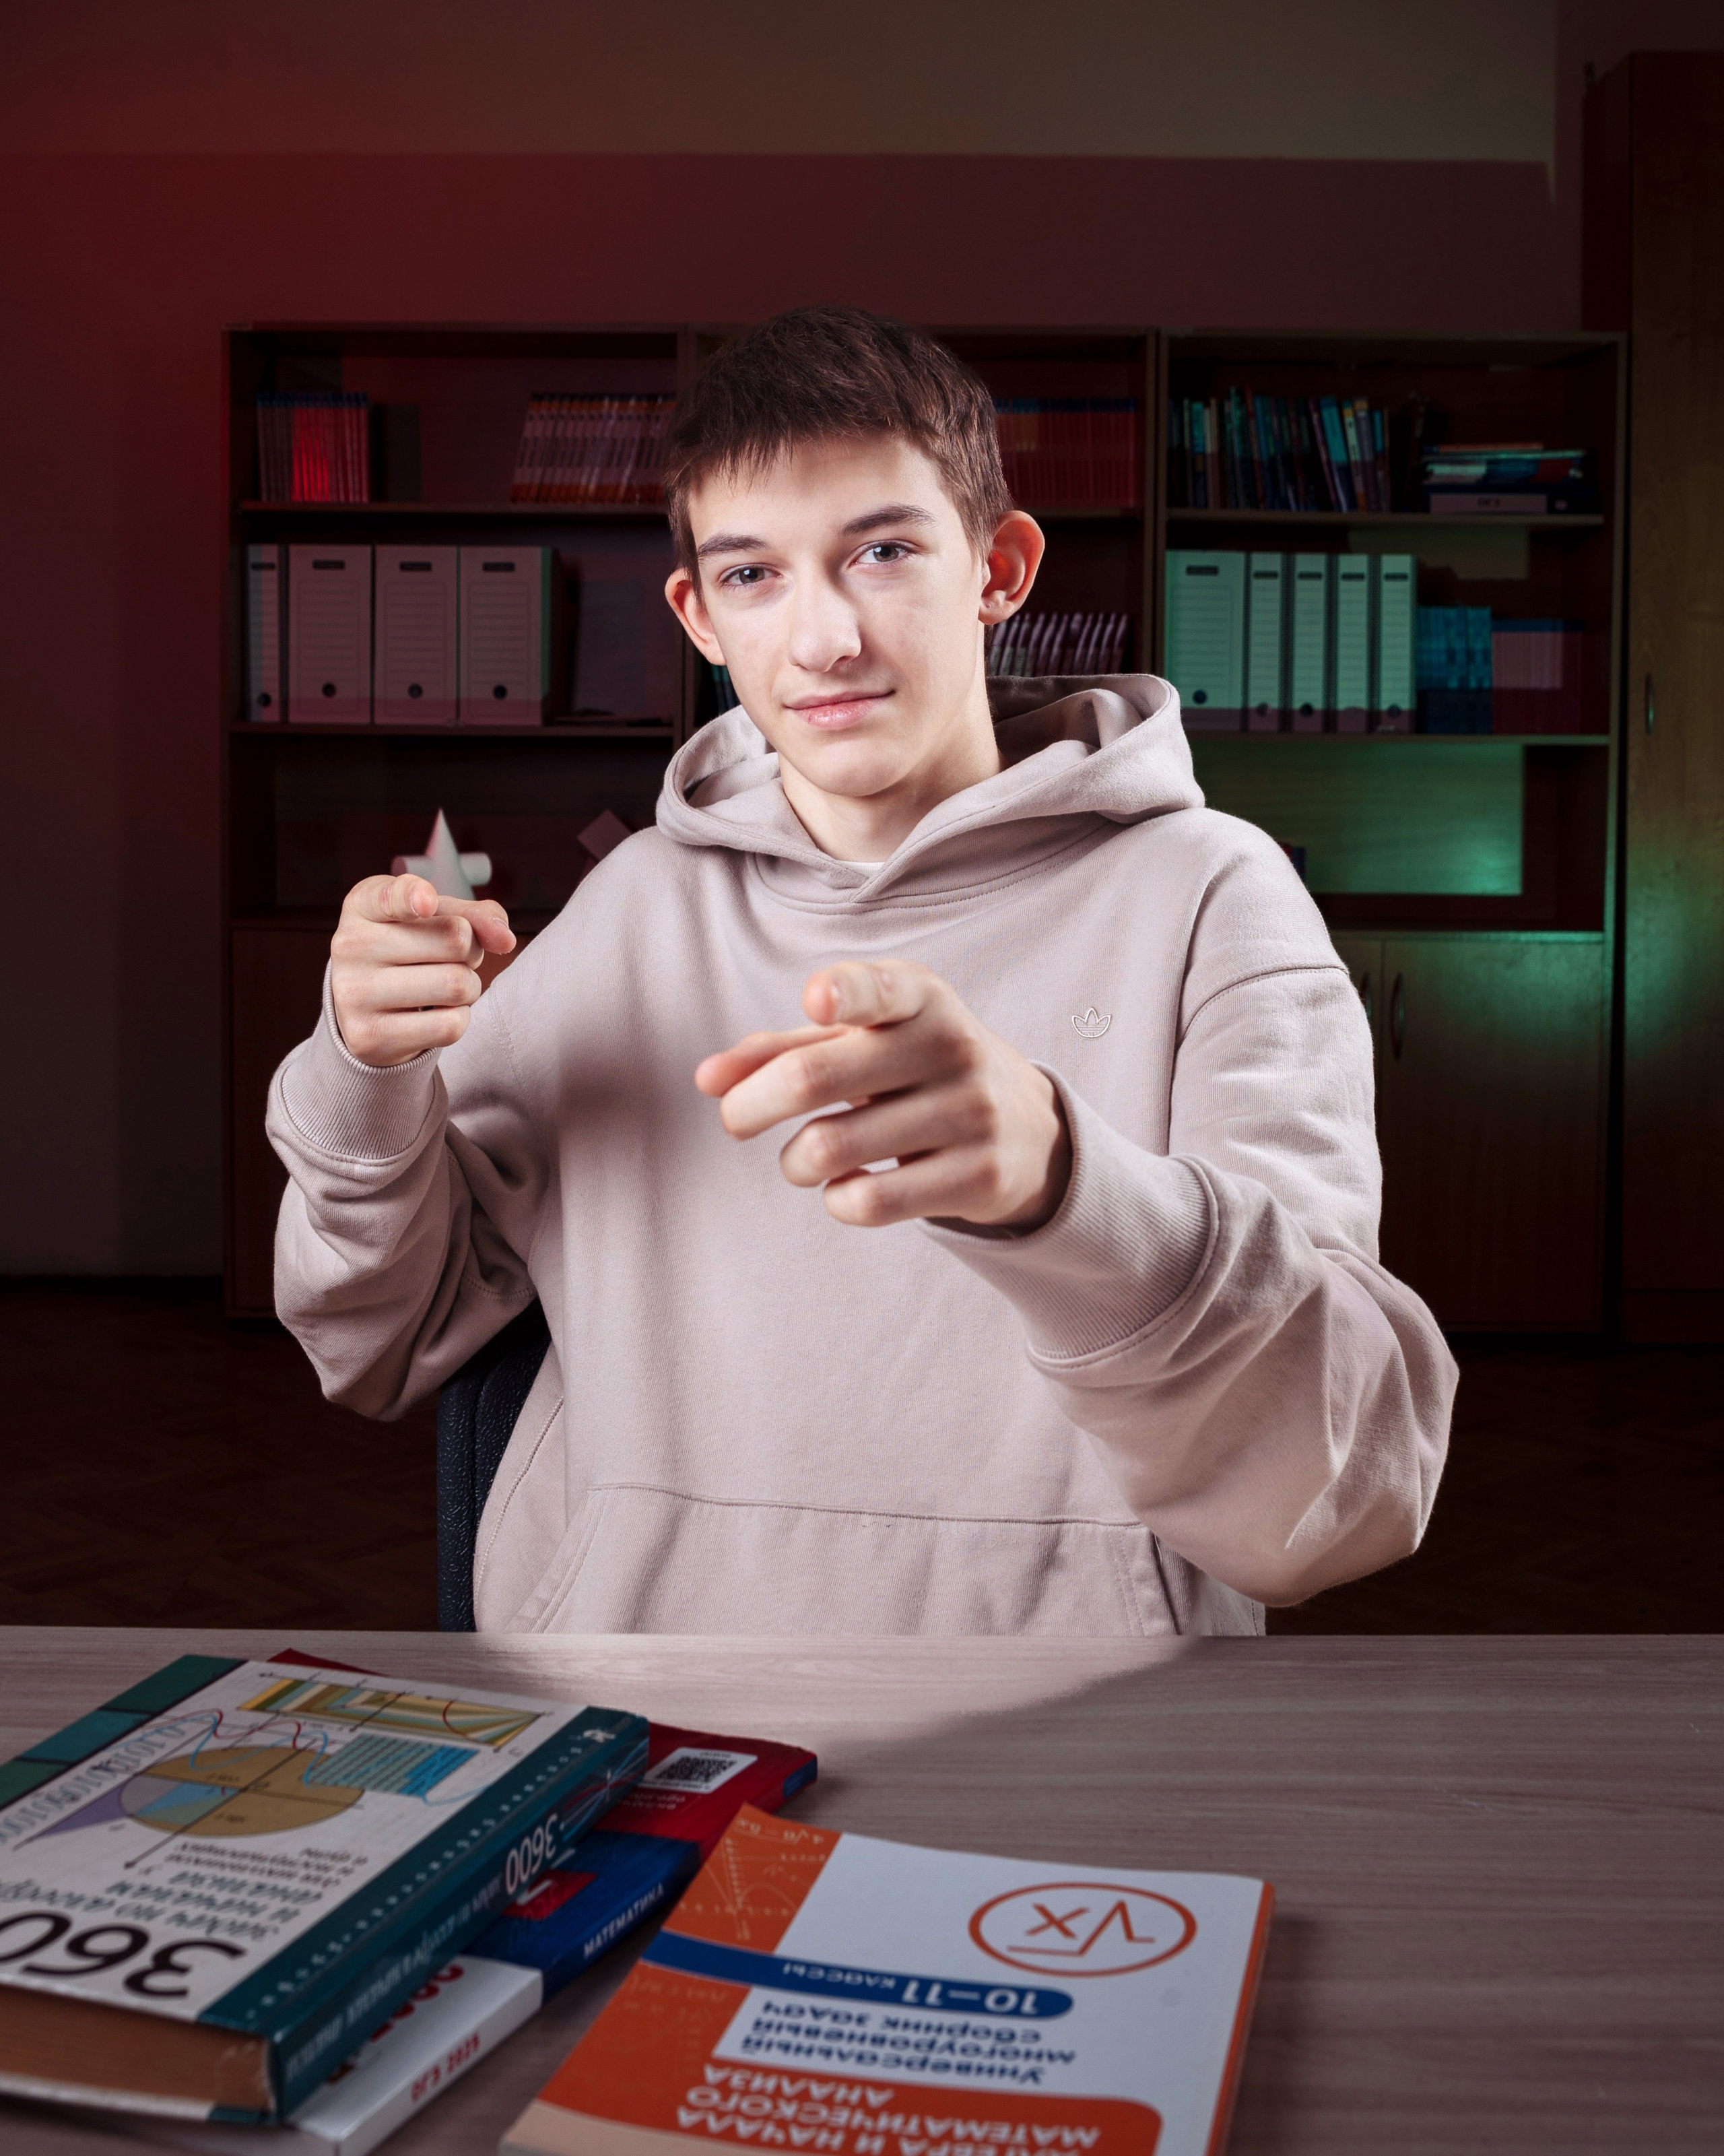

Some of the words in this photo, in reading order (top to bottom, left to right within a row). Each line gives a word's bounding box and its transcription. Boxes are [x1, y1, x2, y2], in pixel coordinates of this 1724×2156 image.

[506, 1813, 558, 1895] 3600
[583, 1881, 664, 1960] МАТЕМАТИКА
[783, 1961, 896, 1990] классы
[762, 2000, 872, 2028] задач
[882, 2018, 1042, 2044] сборник
[742, 2034, 1045, 2085] Универсальный
[752, 2017, 1075, 2065] многоуровневый
[703, 2063, 895, 2109] АНАЛИЗА
[676, 2105, 846, 2151] НАЧАЛА
[686, 2085, 1102, 2149] МАТЕМАТИЧЕСКОГО
[854, 2132, 886, 2155] И
